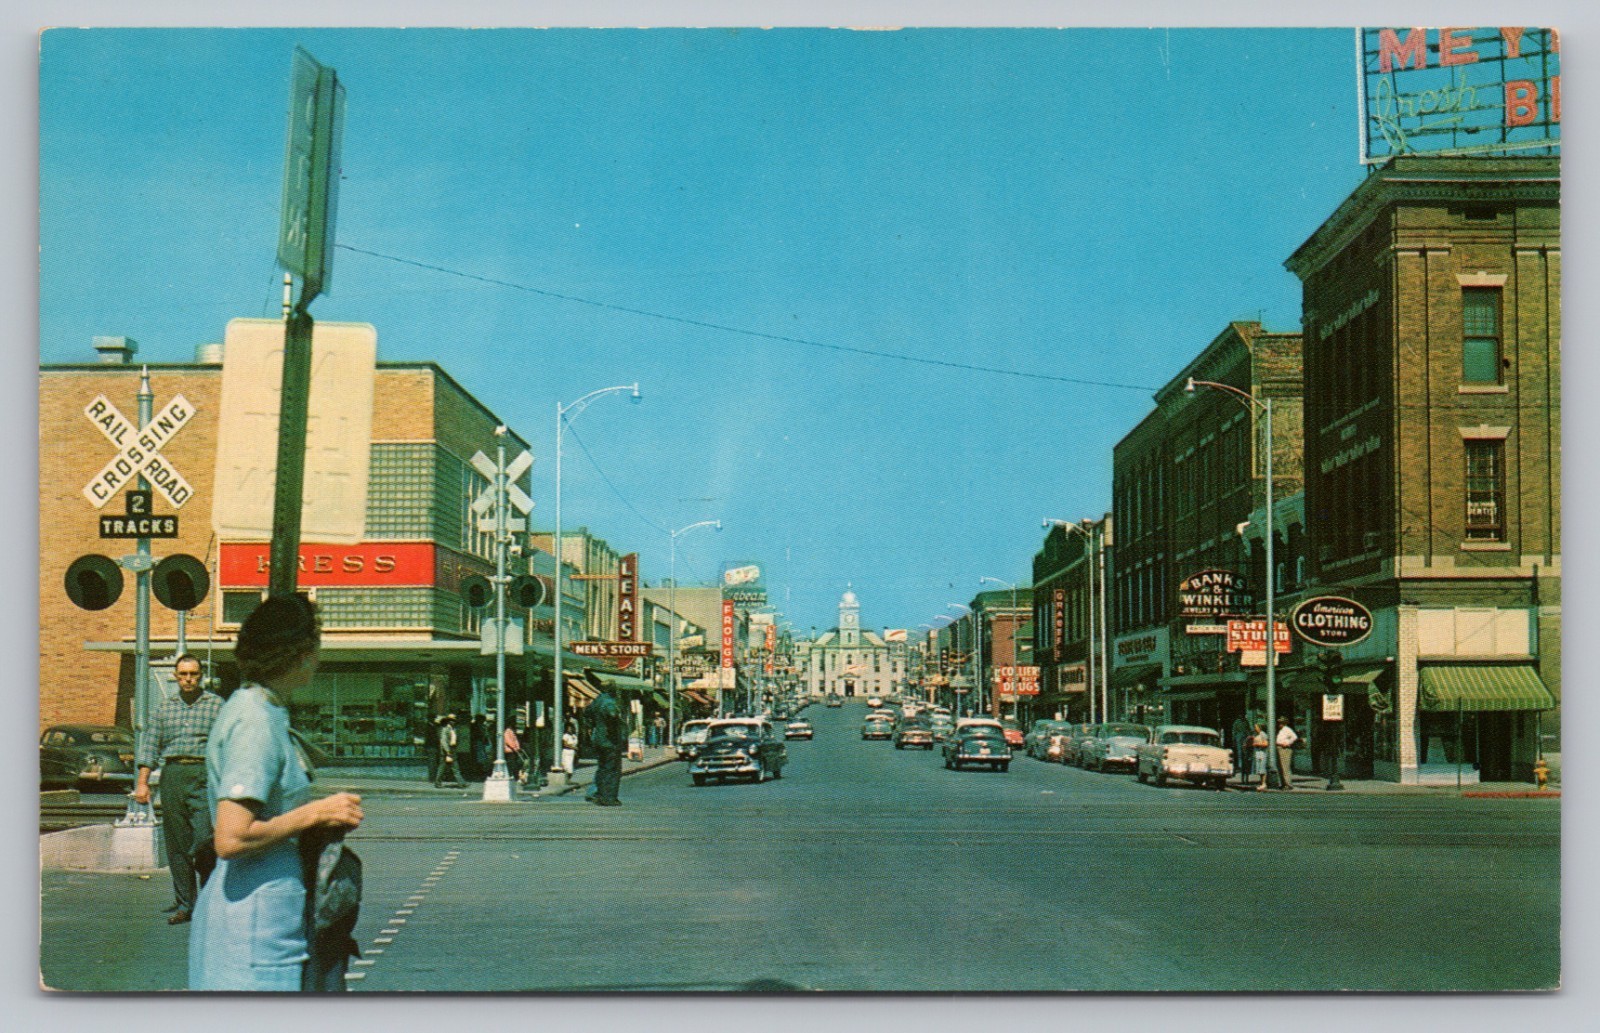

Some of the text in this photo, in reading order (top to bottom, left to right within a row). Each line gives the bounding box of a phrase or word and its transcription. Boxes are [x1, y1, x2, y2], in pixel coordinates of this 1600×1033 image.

[1379, 27, 1561, 73] MEY
[1505, 75, 1561, 127] B
[1375, 66, 1480, 154] fresh
[88, 400, 189, 504] RAIL ROAD
[91, 404, 187, 500] CROSSING
[131, 495, 145, 513] 2
[102, 519, 175, 533] TRACKS
[1190, 573, 1244, 590] BANKS
[1213, 584, 1223, 594] &
[620, 561, 632, 638] LEA'S
[1181, 594, 1252, 606] WINKLER
[1313, 603, 1354, 615] American
[1298, 613, 1369, 630] CLOTHING
[1320, 629, 1348, 637] STORE
[575, 645, 647, 655] MEN'S STORE
